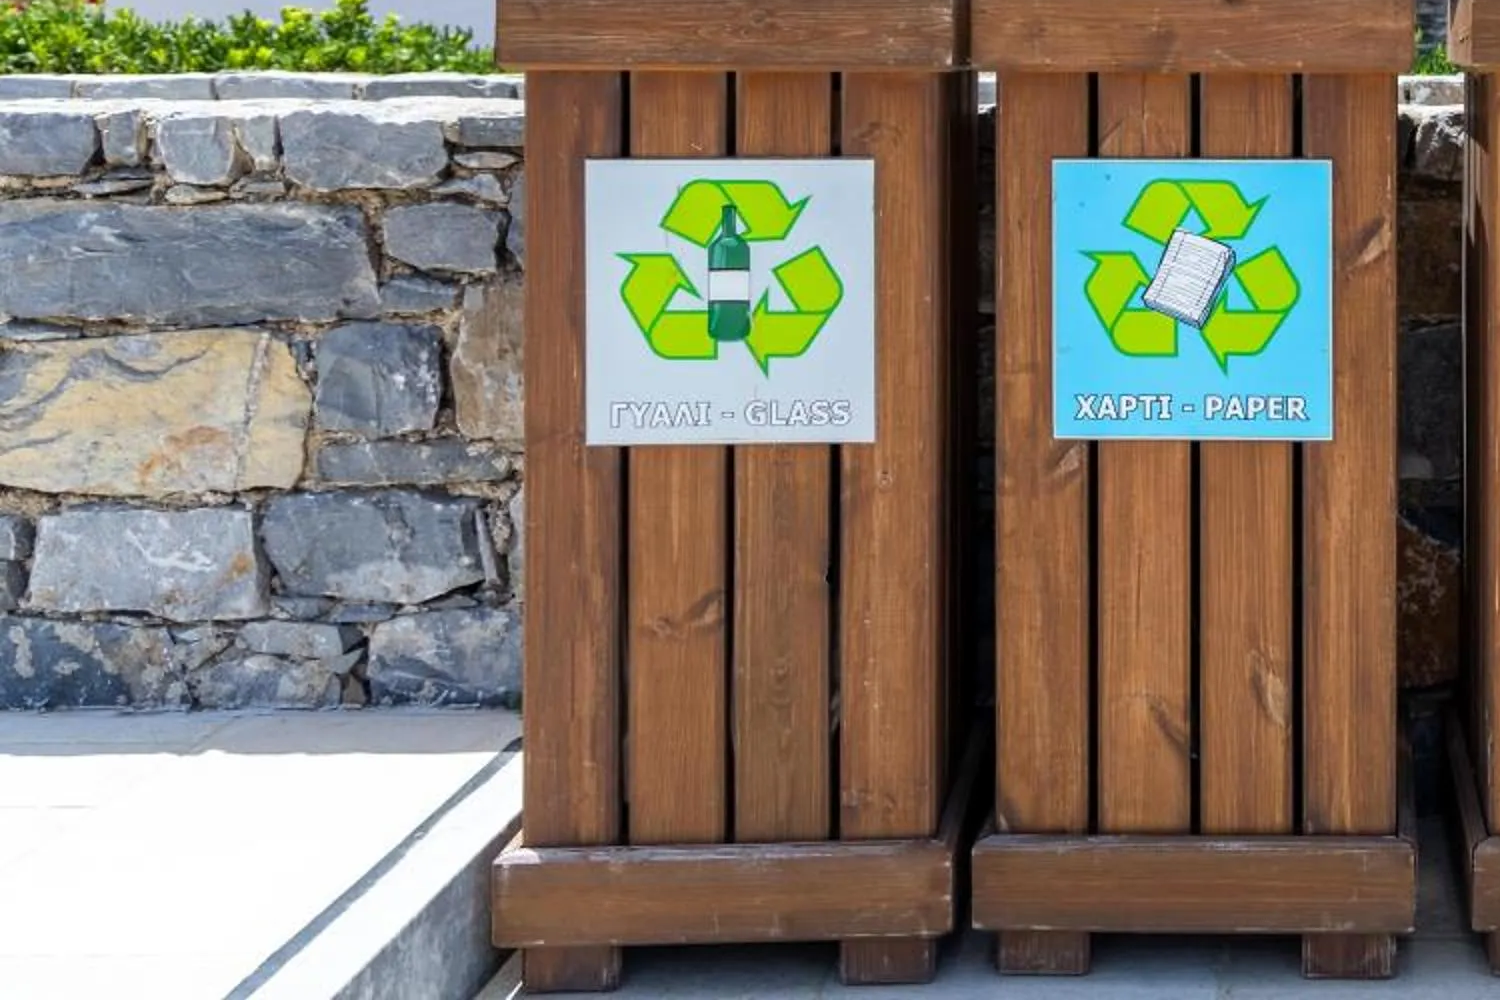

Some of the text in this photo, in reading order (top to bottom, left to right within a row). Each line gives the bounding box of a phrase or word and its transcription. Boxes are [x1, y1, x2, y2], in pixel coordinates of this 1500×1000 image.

[609, 401, 711, 428] ΓΥΑΛΙ
[744, 399, 851, 427] GLASS
[1074, 395, 1173, 420] ΧΑΡΤΙ
[1204, 395, 1309, 420] PAPER
